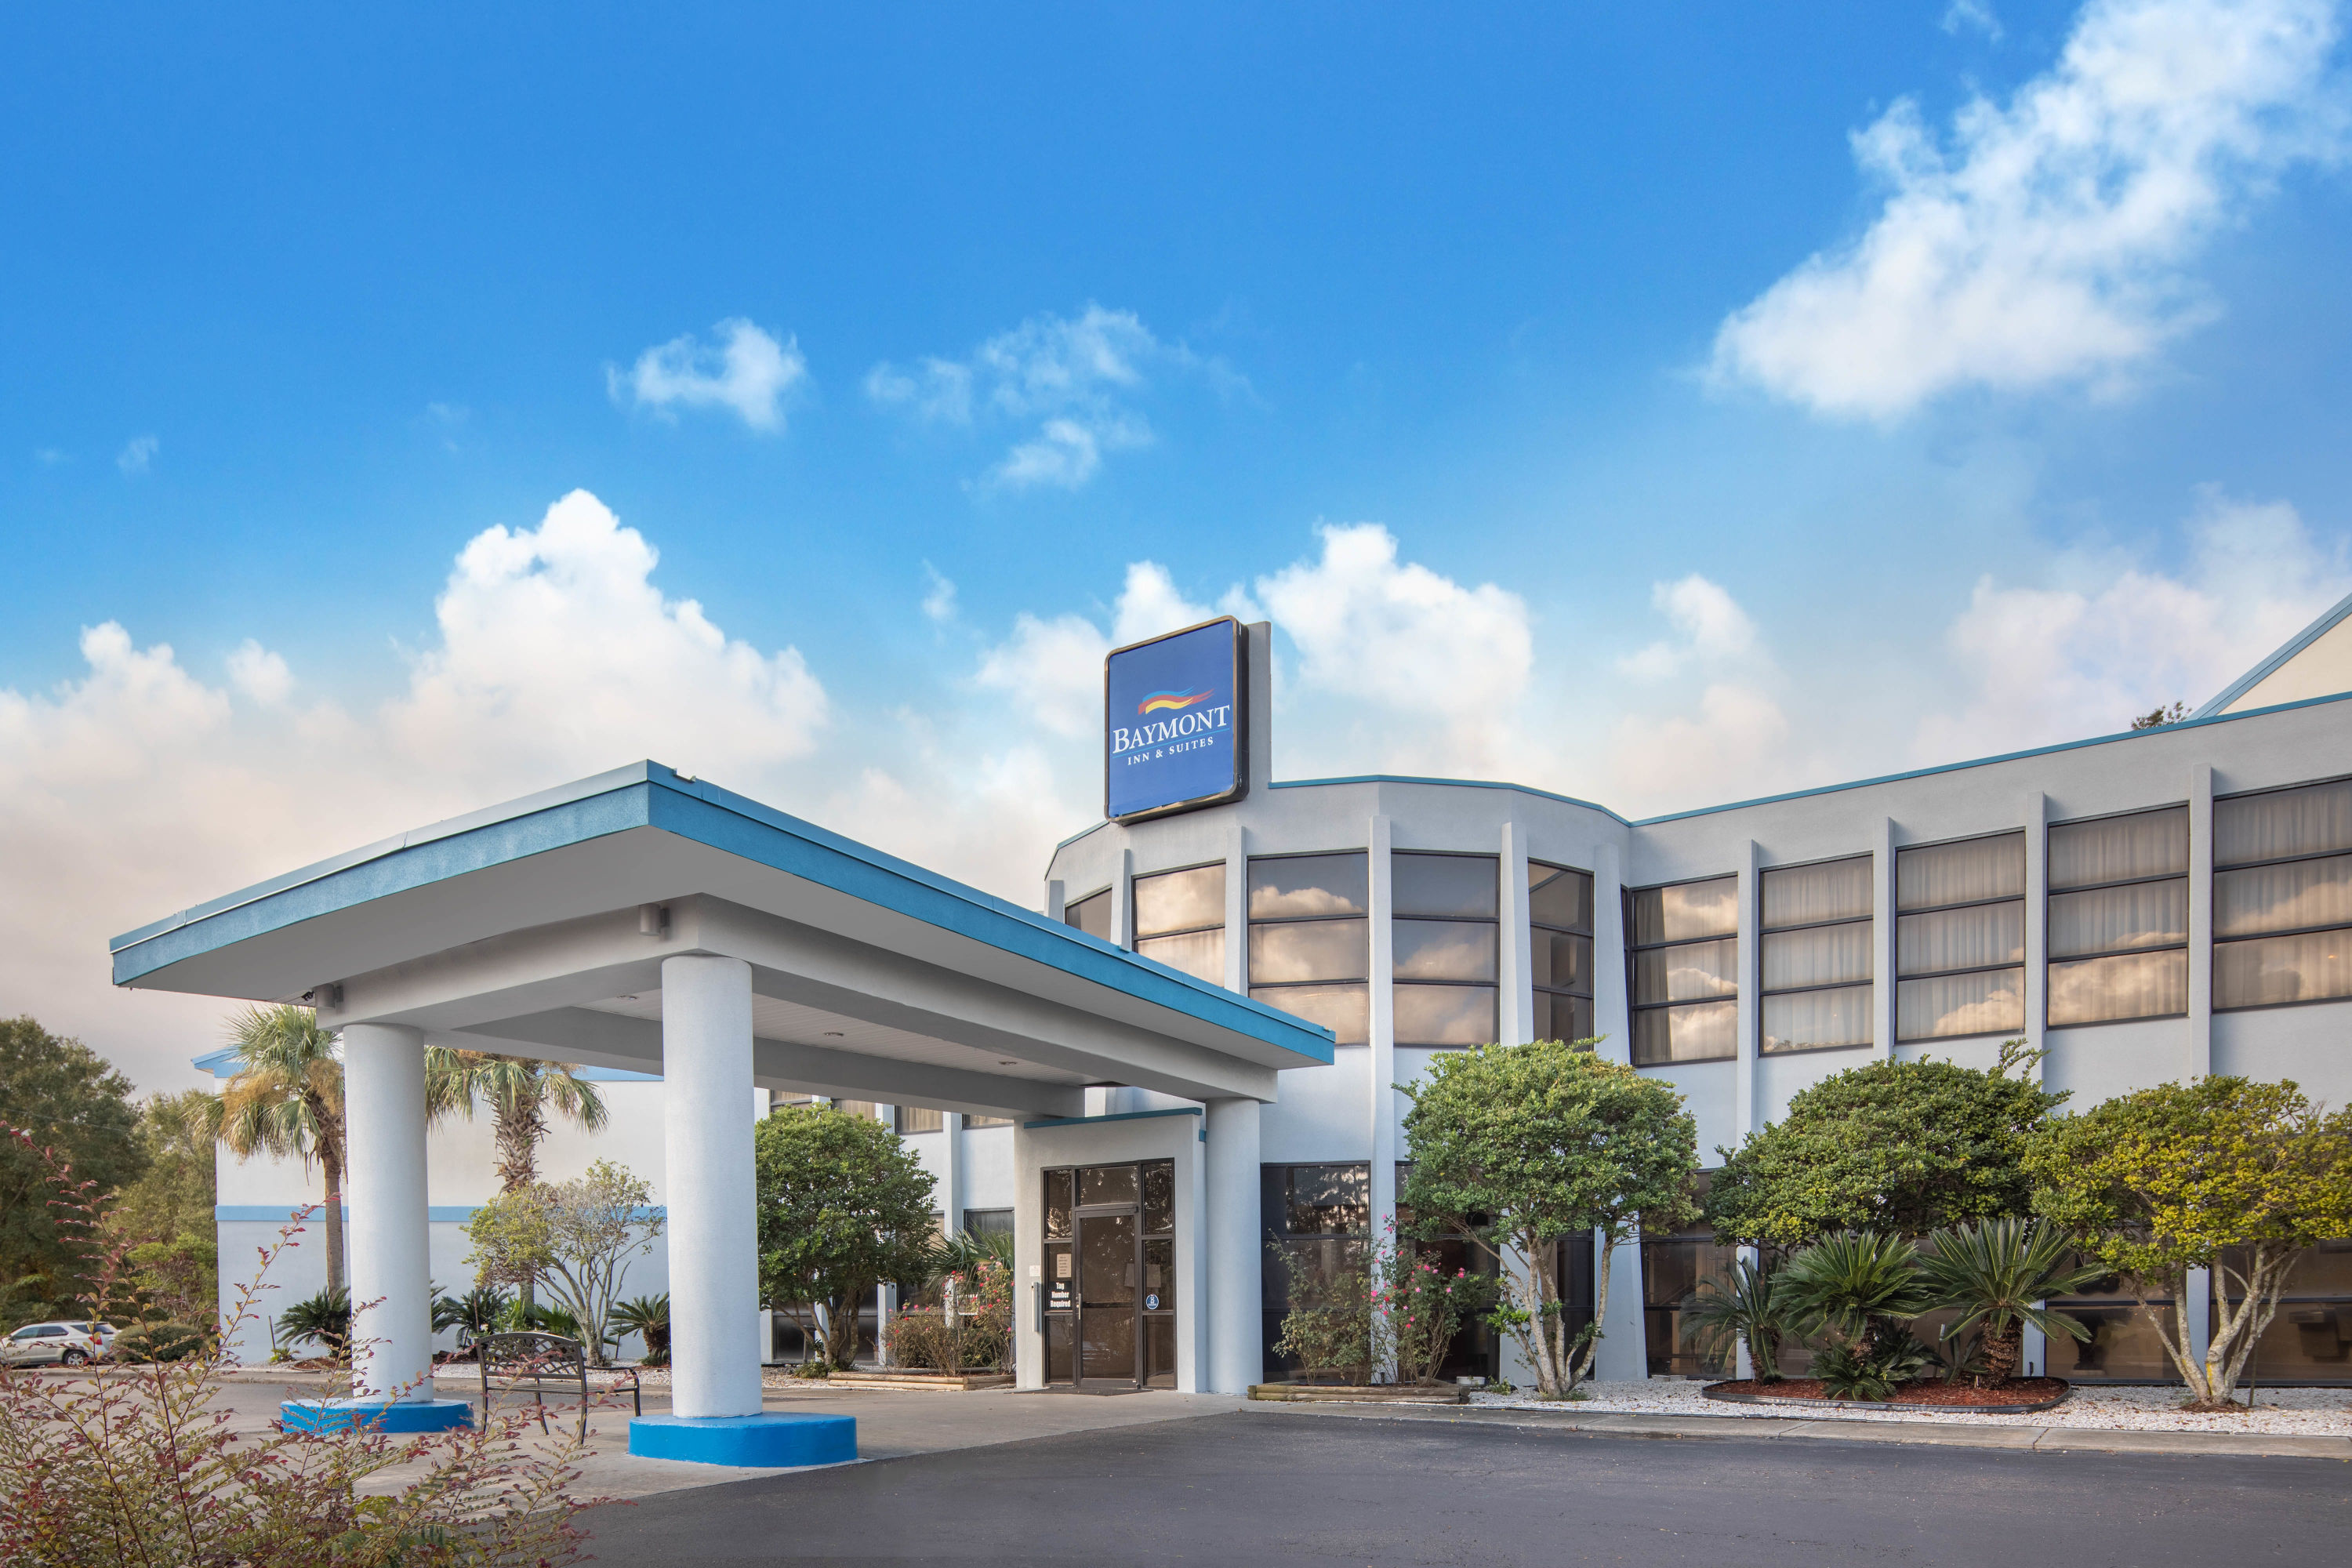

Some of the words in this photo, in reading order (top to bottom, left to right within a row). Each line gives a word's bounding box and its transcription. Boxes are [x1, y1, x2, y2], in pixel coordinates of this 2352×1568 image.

[1112, 704, 1230, 753] BAYMONT
[1127, 752, 1149, 765] INN
[1156, 749, 1163, 758] &
[1169, 736, 1214, 755] SUITES
